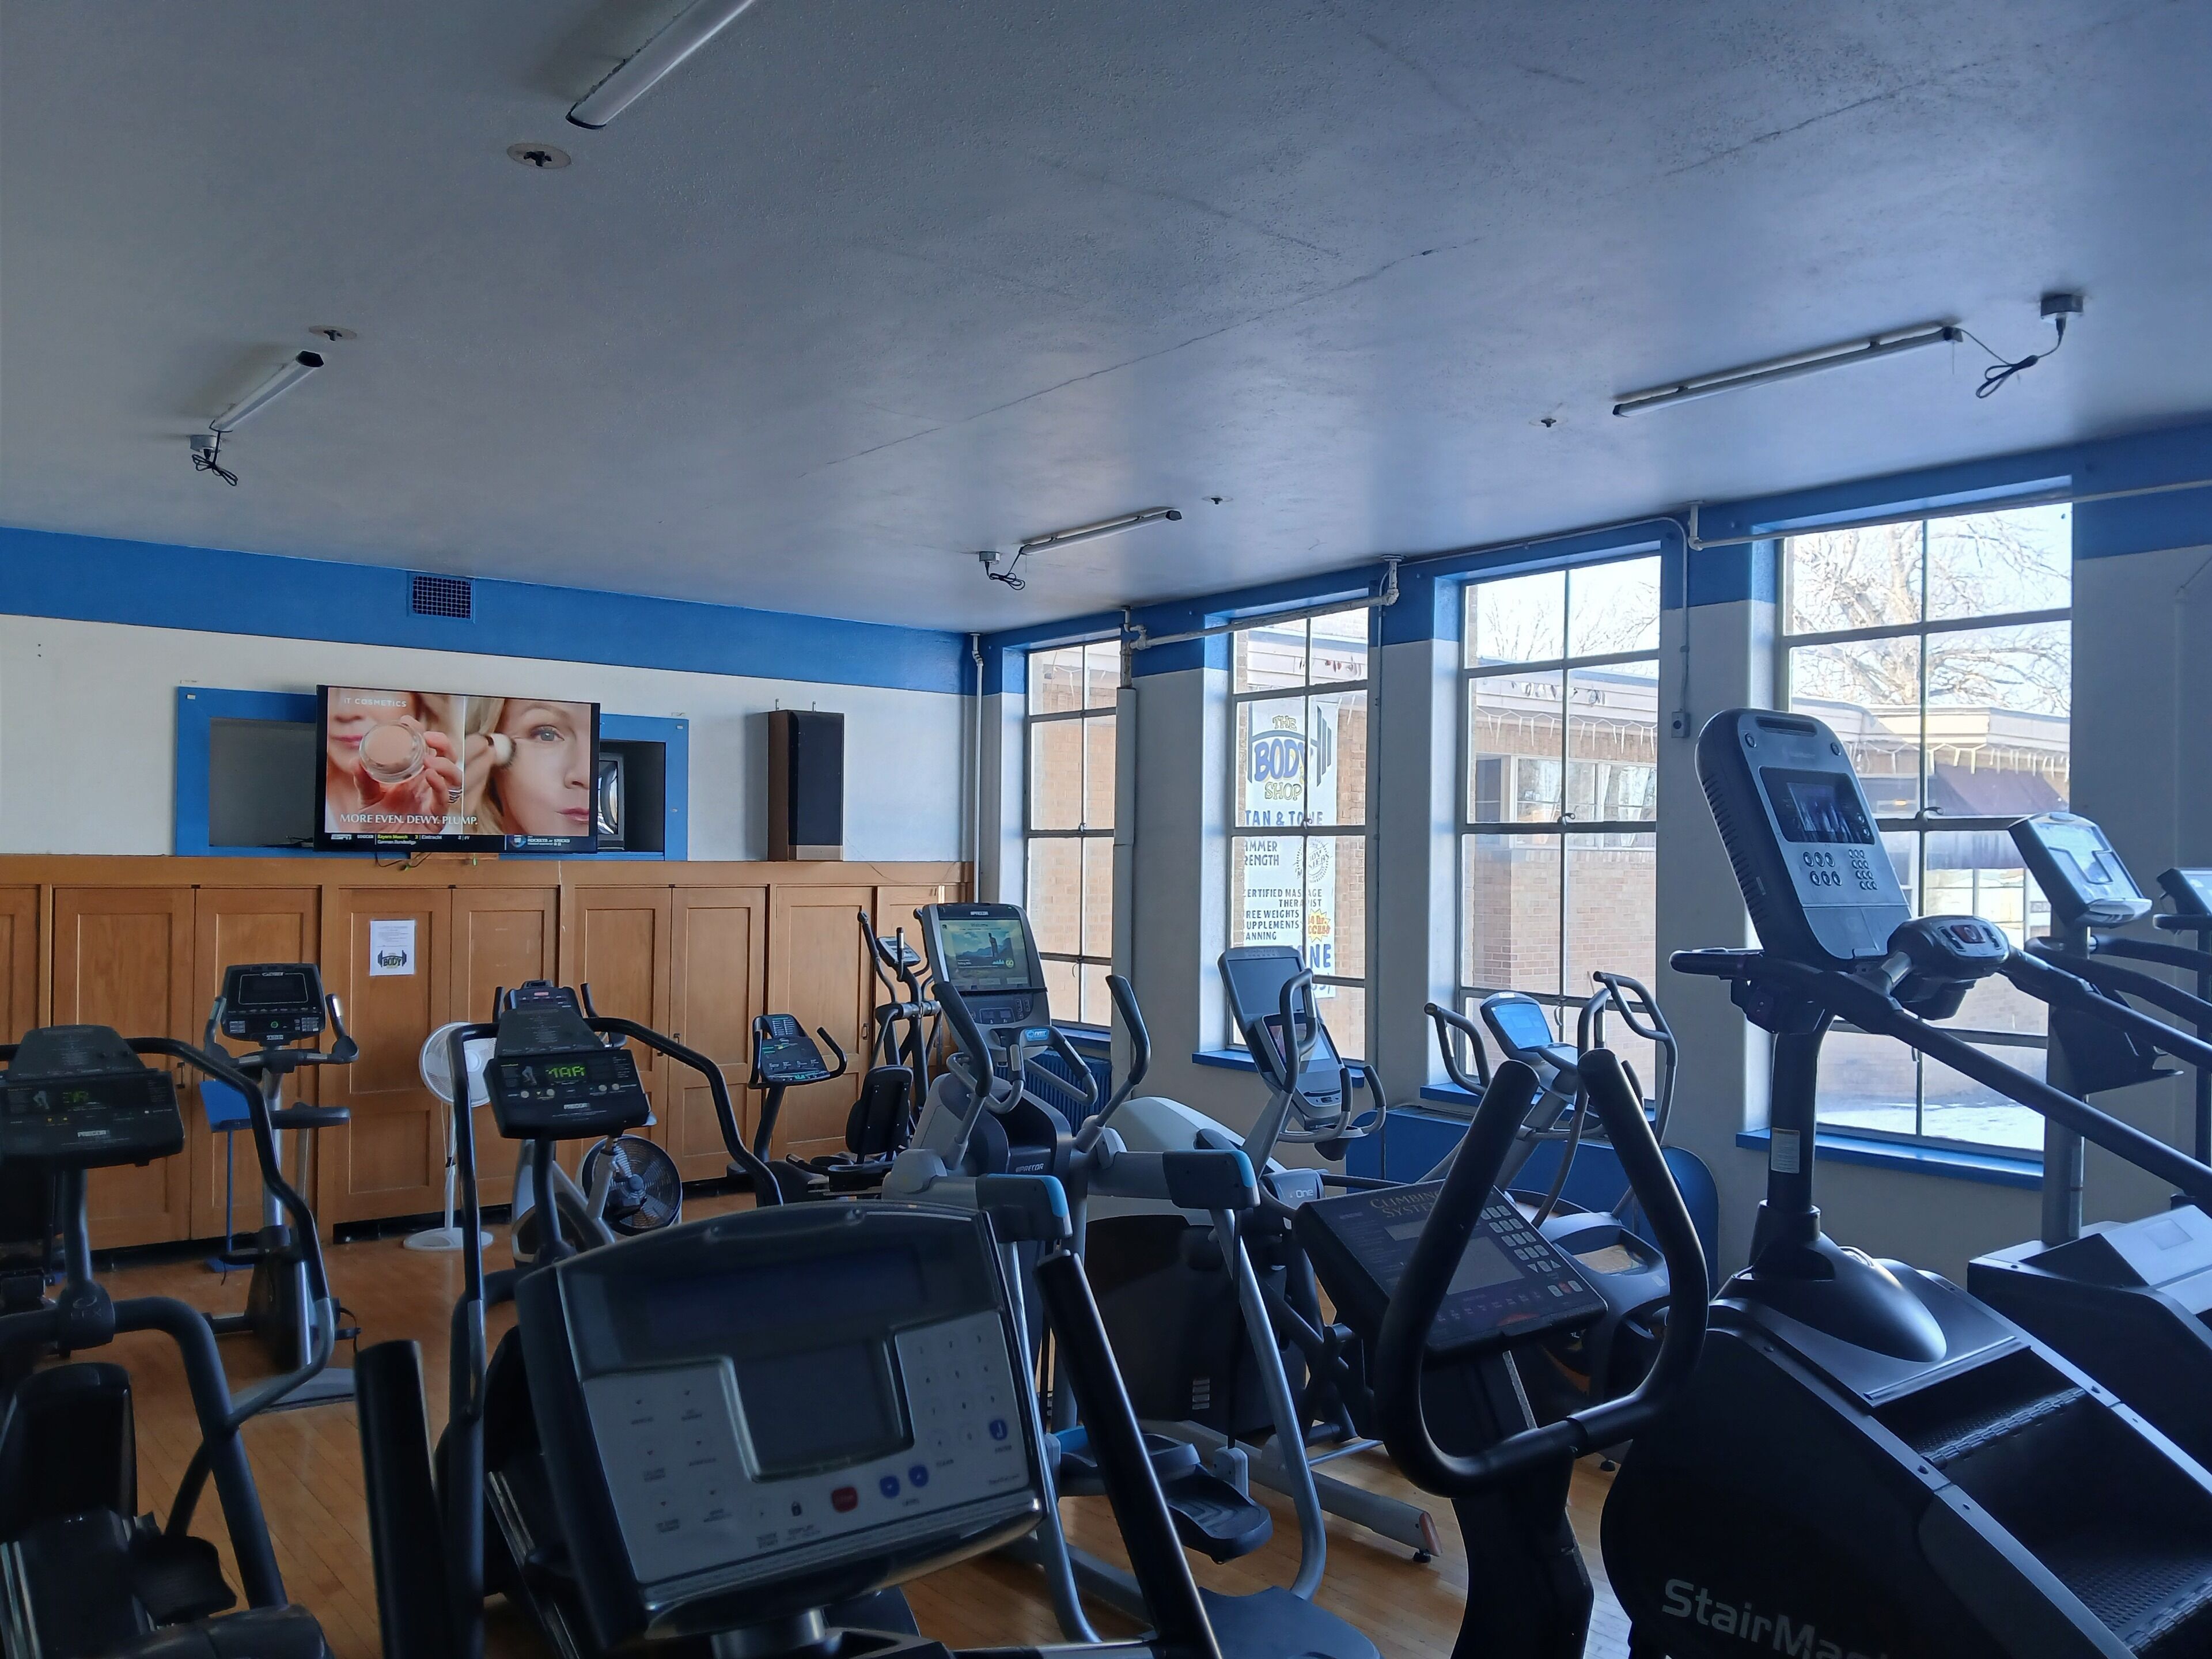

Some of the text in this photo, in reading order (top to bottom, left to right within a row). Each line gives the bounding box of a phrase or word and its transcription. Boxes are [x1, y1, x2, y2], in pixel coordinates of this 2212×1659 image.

[355, 698, 407, 707] COSMETICS
[1272, 715, 1297, 731] THE
[1264, 781, 1302, 801] SHOP
[340, 814, 478, 825] MORE EVEN. DEWY. PLUMP.
[1245, 810, 1271, 826] TAN
[1276, 811, 1285, 825] &
[1244, 840, 1278, 851] AMMER
[1244, 854, 1279, 866] RENGTH
[1244, 889, 1322, 897] ERTIFIED MASAGE
[1279, 899, 1322, 907] THERAIST
[1246, 910, 1299, 918] REE WEIGHTS
[1247, 920, 1300, 929] UPPLEMENTS
[1245, 931, 1277, 940] ANNING
[383, 957, 402, 967] BODY
[1296, 1189, 1313, 1198] One
[1662, 1578, 1888, 1659] StairMa
